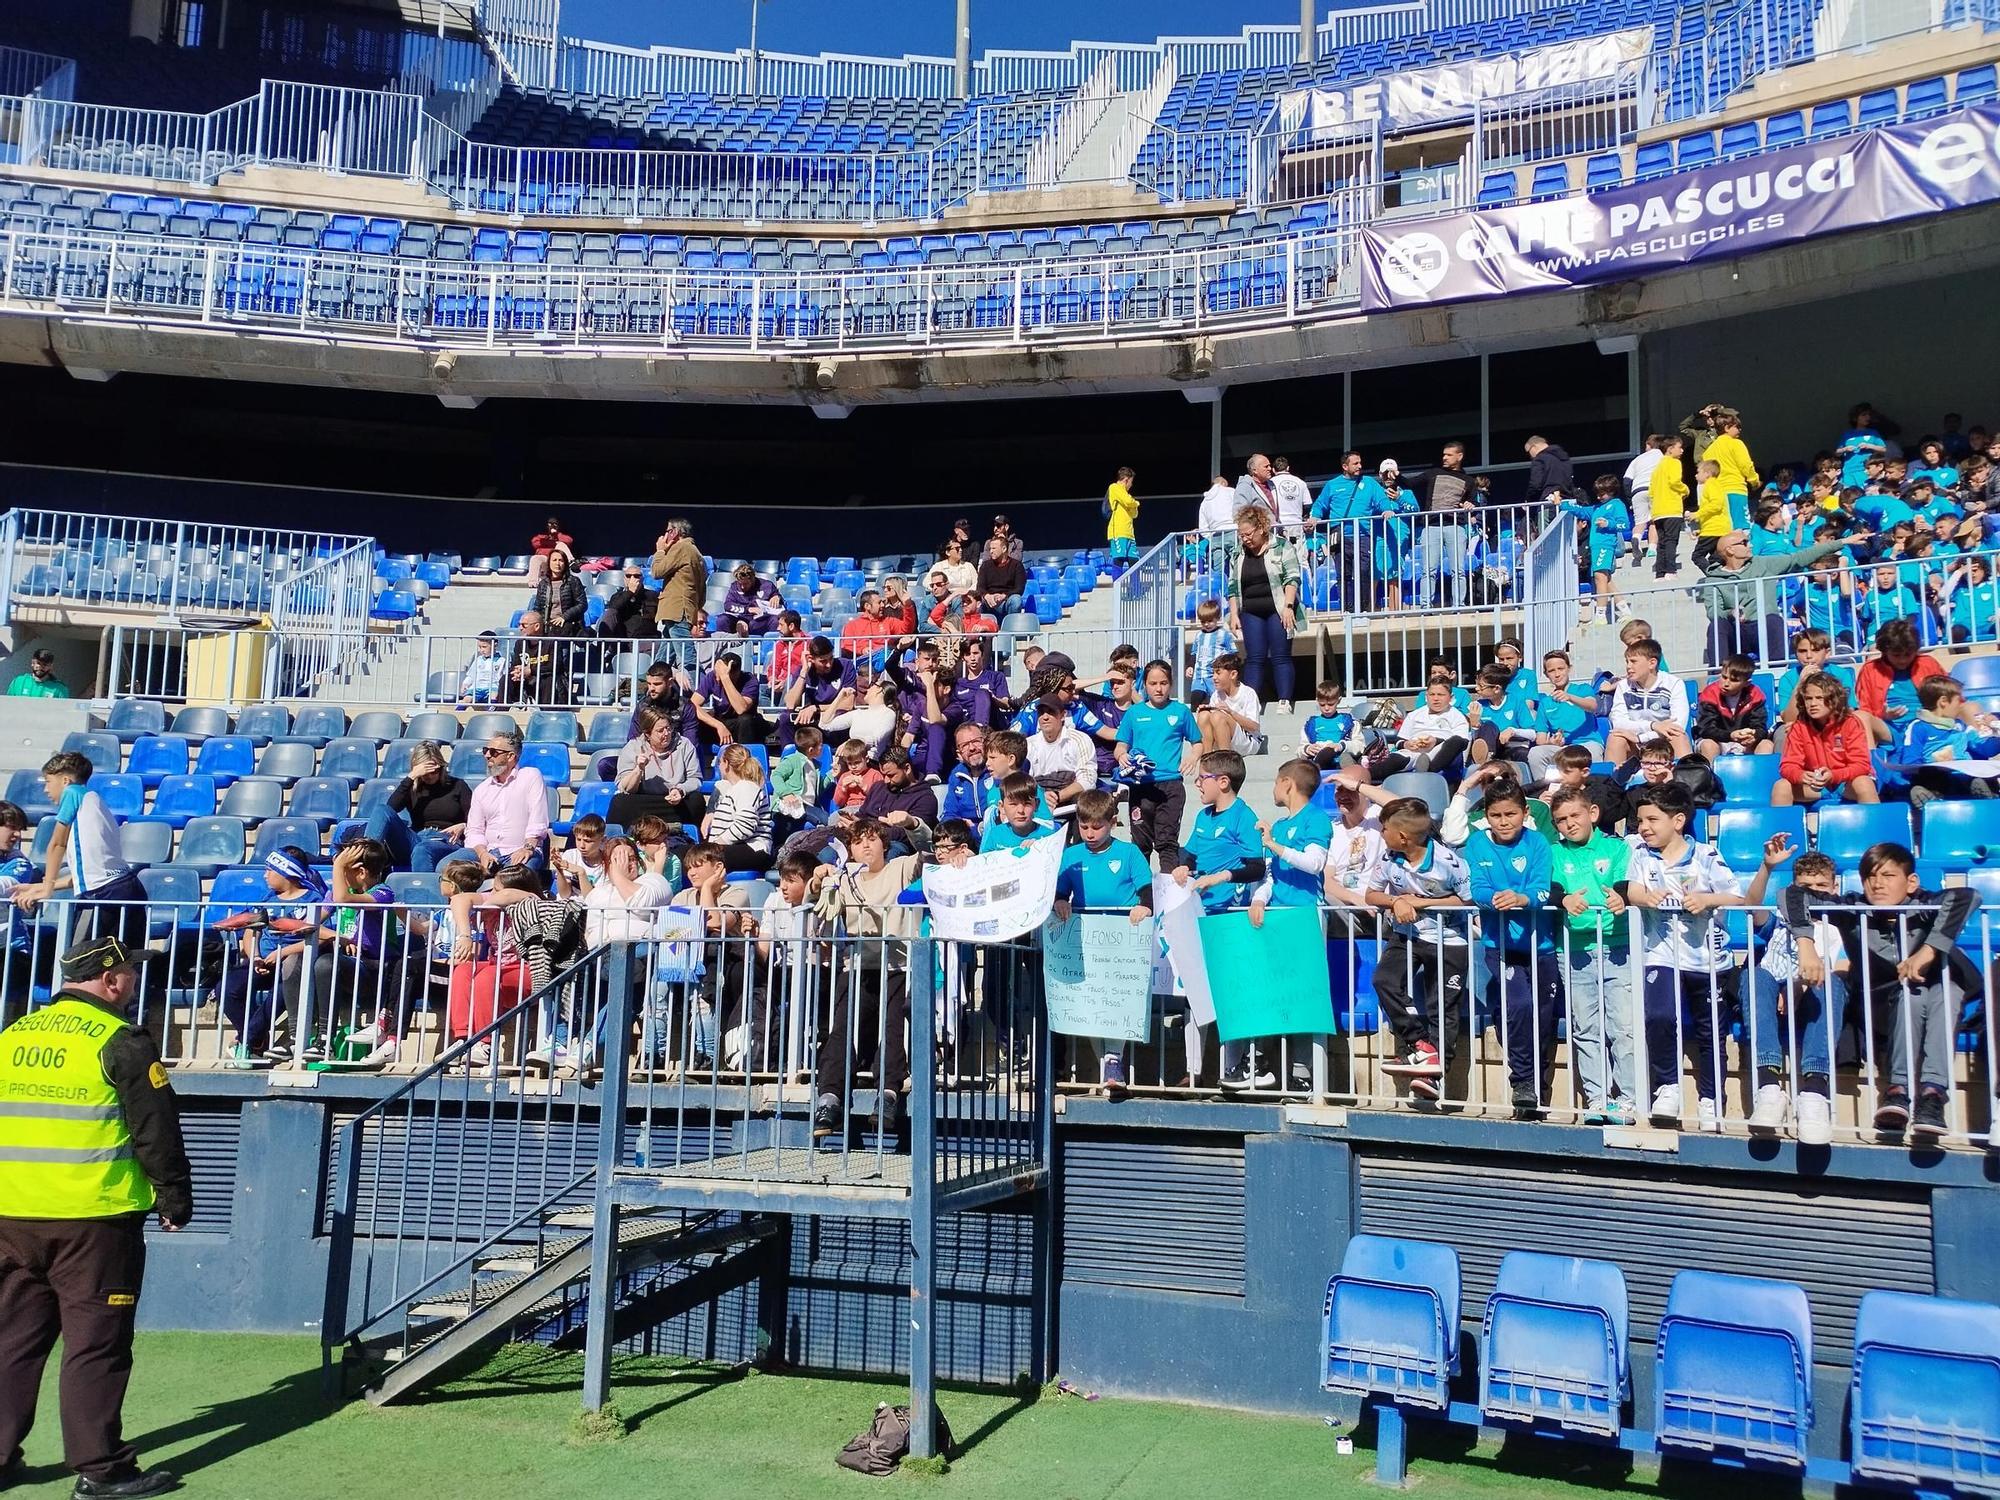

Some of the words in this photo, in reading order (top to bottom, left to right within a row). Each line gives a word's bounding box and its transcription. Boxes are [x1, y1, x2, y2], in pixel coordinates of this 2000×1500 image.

[1610, 152, 1855, 238] PASCUCCI
[11, 1013, 107, 1038] SEGURIDAD
[12, 1045, 67, 1069] 0006
[8, 1082, 88, 1100] PROSEGUR
